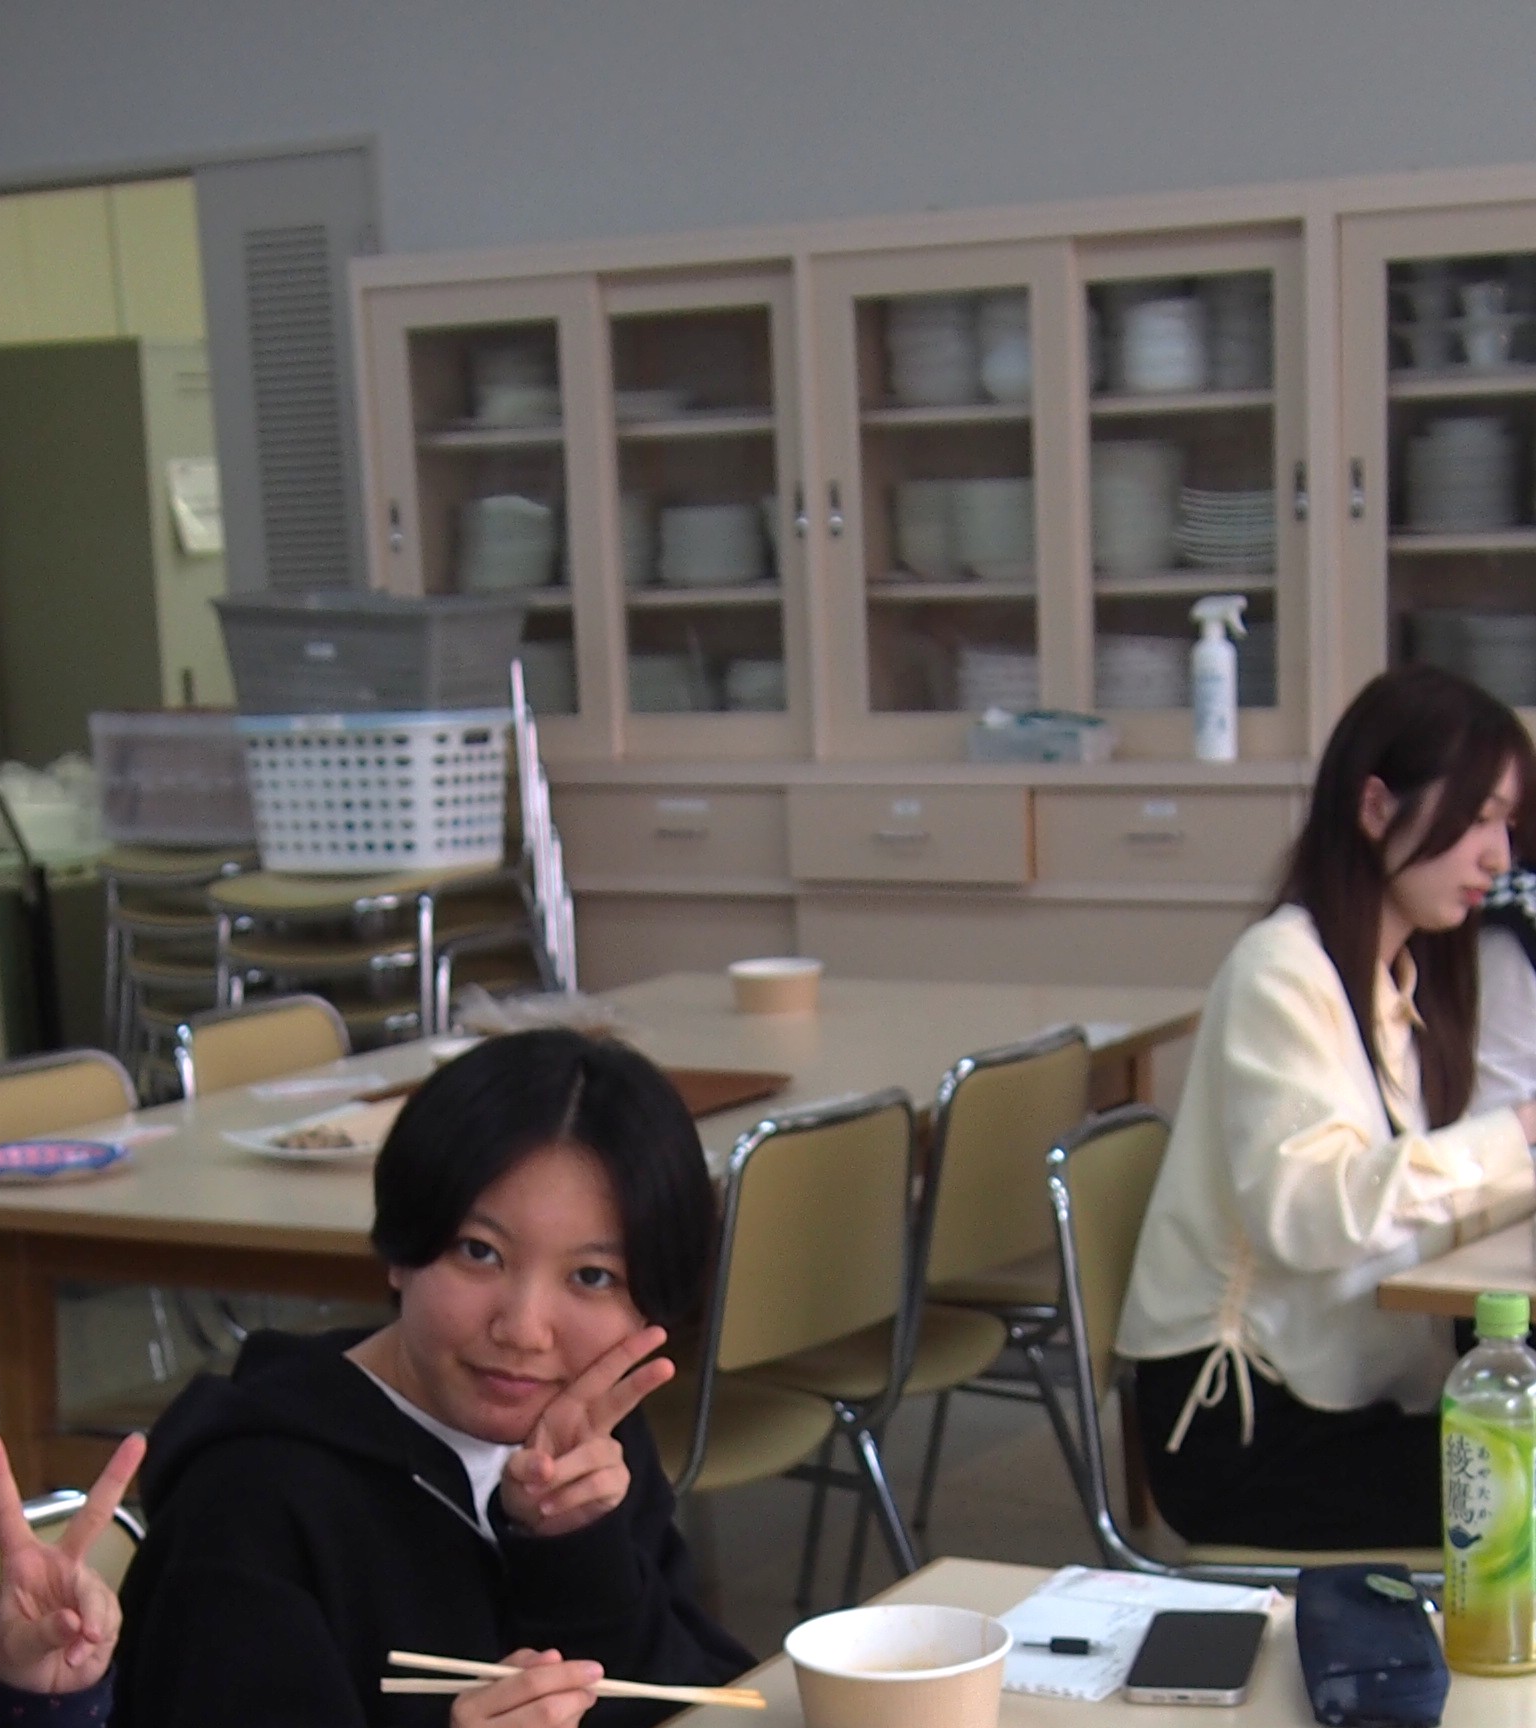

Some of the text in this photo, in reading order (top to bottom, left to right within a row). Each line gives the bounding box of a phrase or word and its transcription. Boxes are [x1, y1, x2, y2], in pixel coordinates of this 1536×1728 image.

[1447, 1432, 1474, 1524] 綾鷹
[1477, 1446, 1492, 1520] あやたか
